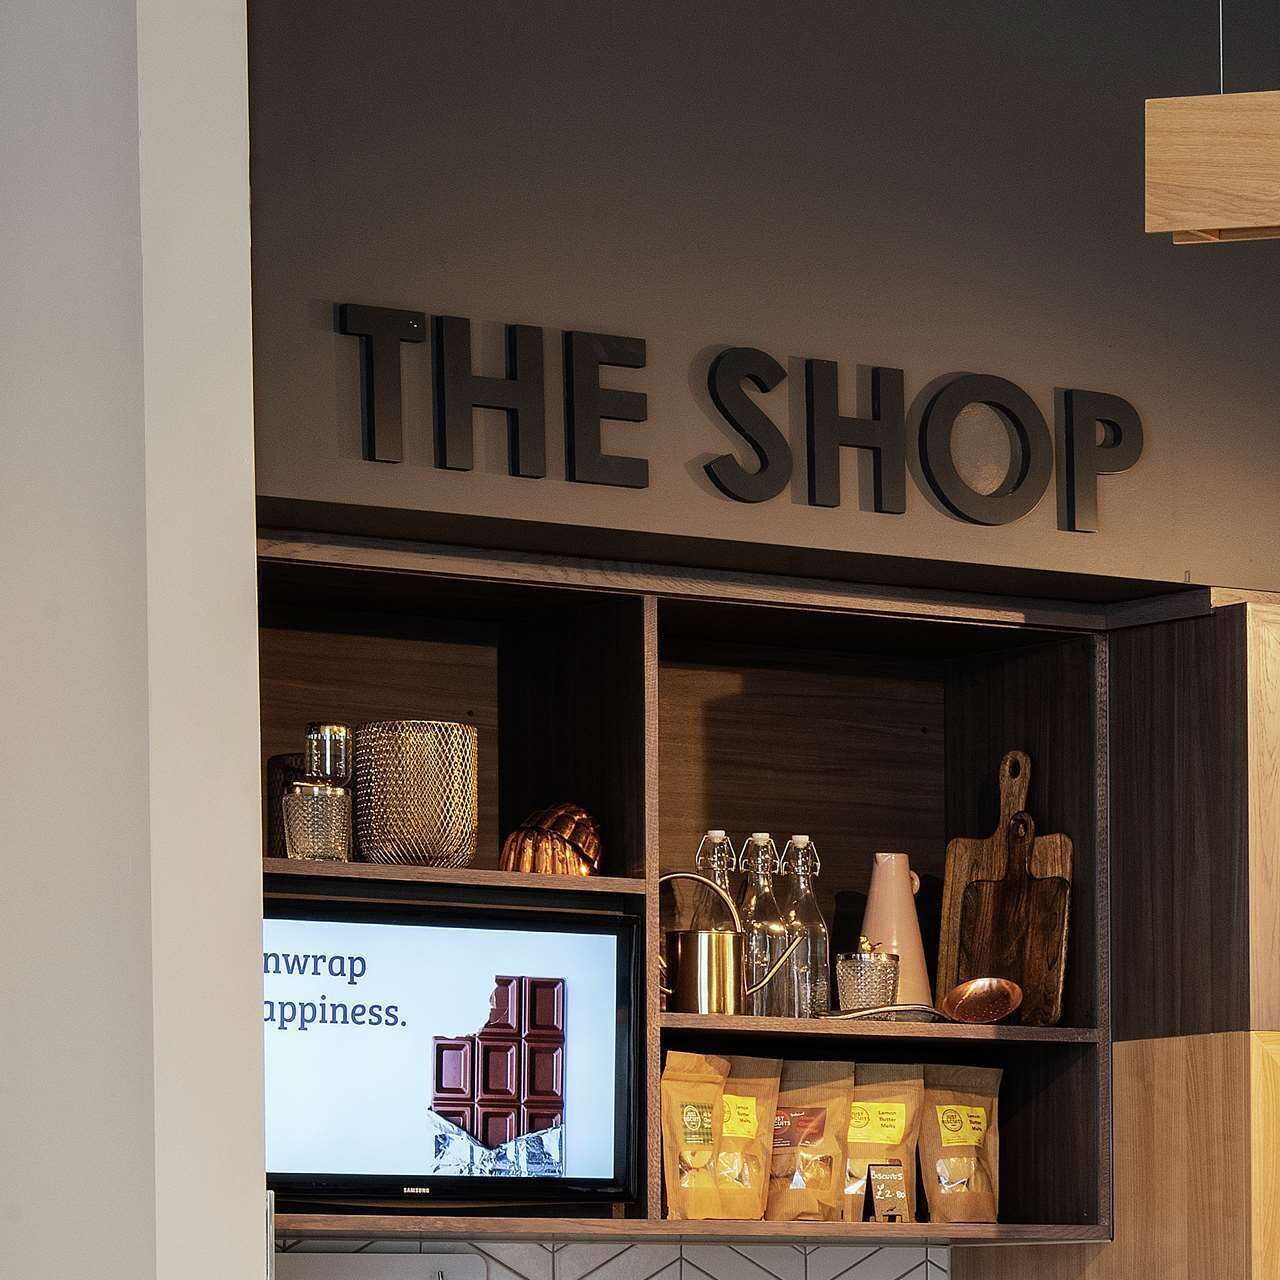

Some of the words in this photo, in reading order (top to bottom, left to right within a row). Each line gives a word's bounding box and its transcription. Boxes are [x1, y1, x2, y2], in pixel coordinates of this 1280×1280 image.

[338, 302, 649, 489] THE
[703, 347, 1144, 533] SHOP
[263, 952, 366, 985] nwrap
[403, 1187, 431, 1195] SAMSUNG
